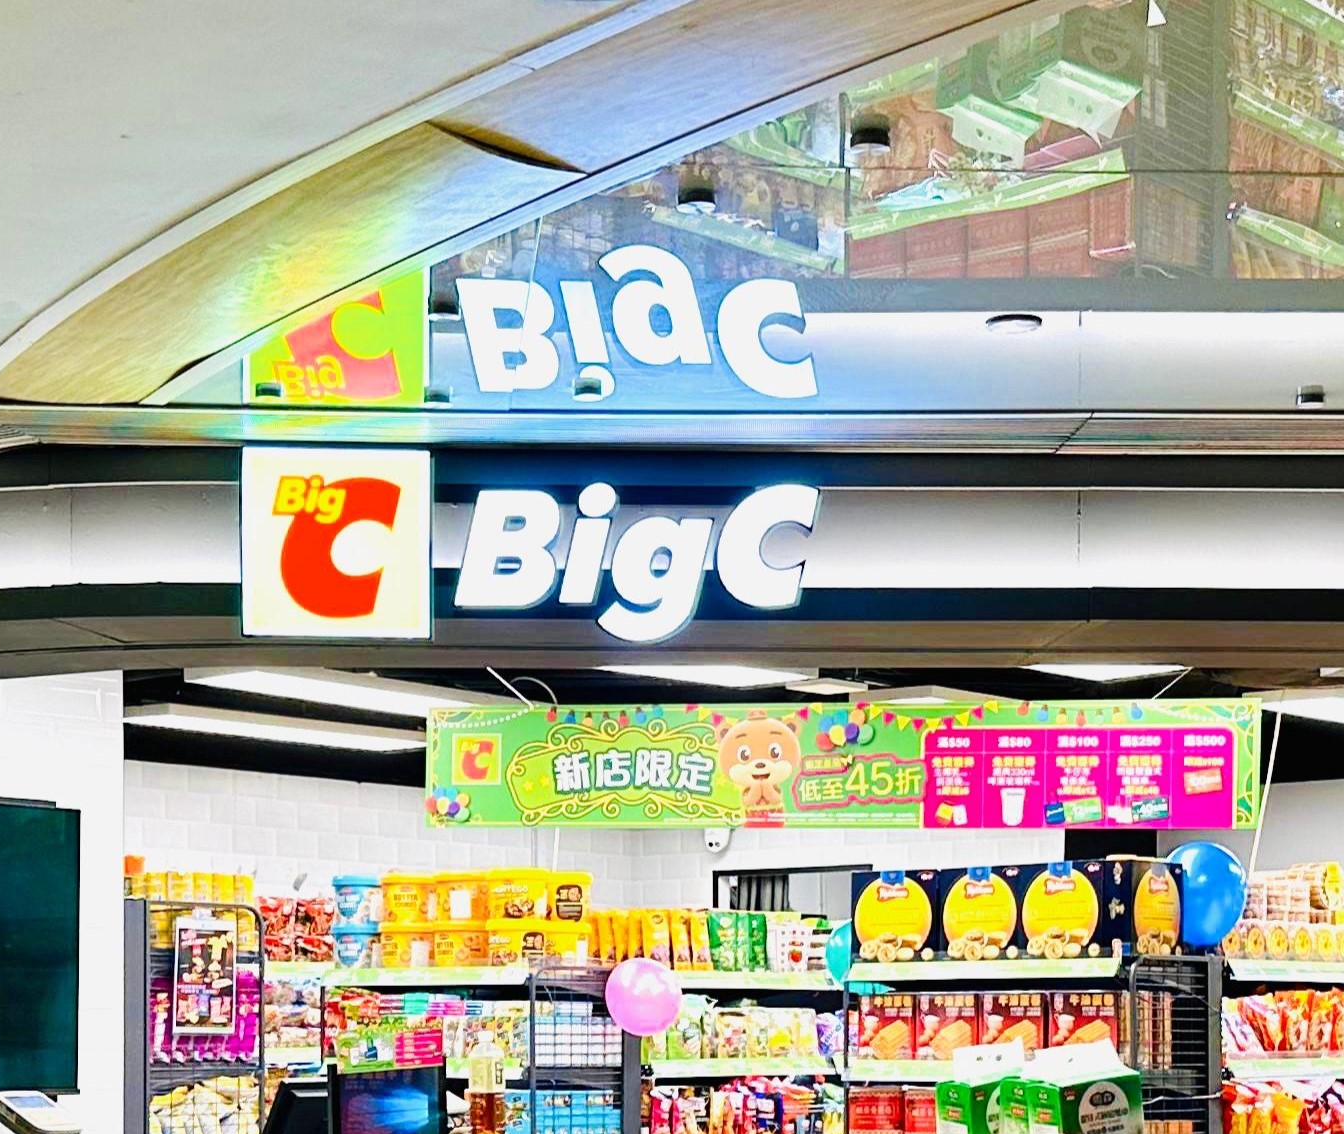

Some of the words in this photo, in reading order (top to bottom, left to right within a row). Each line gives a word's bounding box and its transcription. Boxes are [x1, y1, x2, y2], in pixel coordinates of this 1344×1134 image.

[273, 476, 346, 518] Big
[454, 483, 820, 643] BigC
[553, 749, 716, 795] 新店限定
[799, 761, 922, 802] 低至45折
